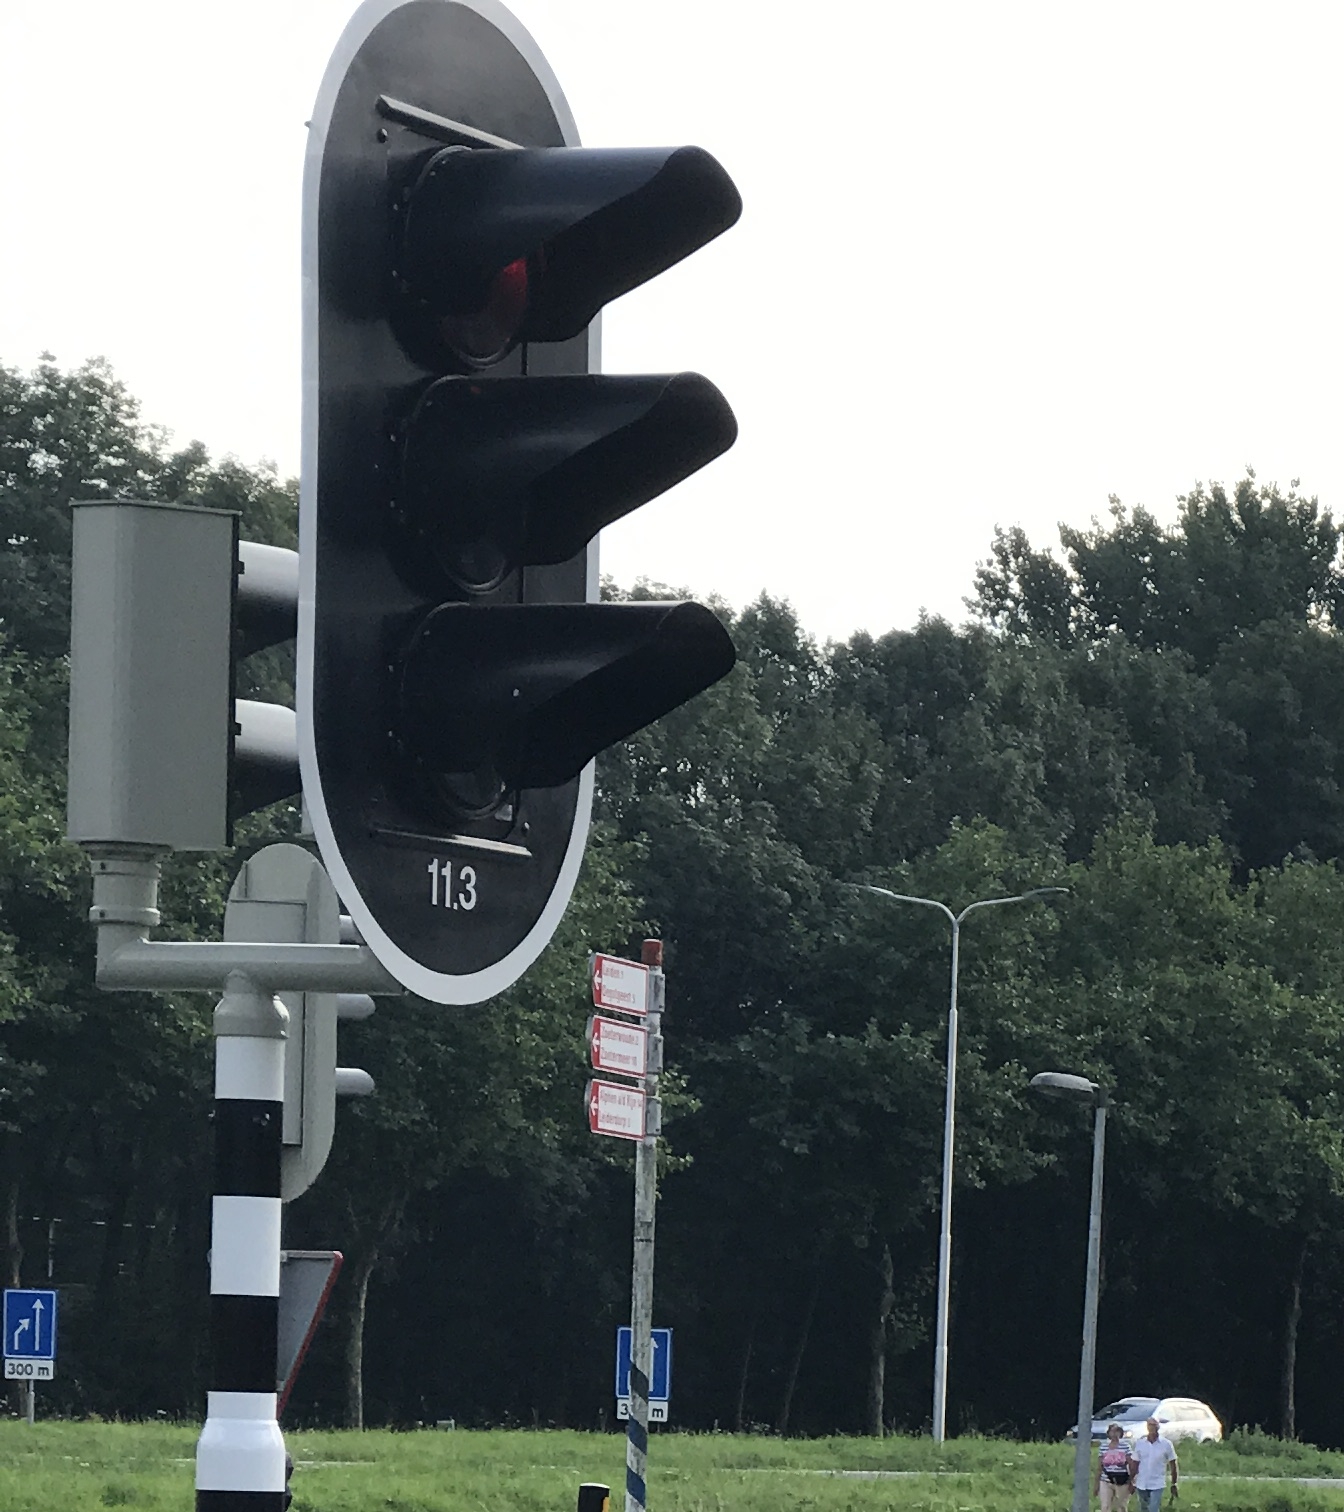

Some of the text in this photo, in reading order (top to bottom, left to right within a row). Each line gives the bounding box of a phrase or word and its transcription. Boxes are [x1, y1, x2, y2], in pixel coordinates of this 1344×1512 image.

[427, 858, 477, 910] 11.3
[8, 1363, 49, 1376] 300 m
[652, 1407, 664, 1418] m
